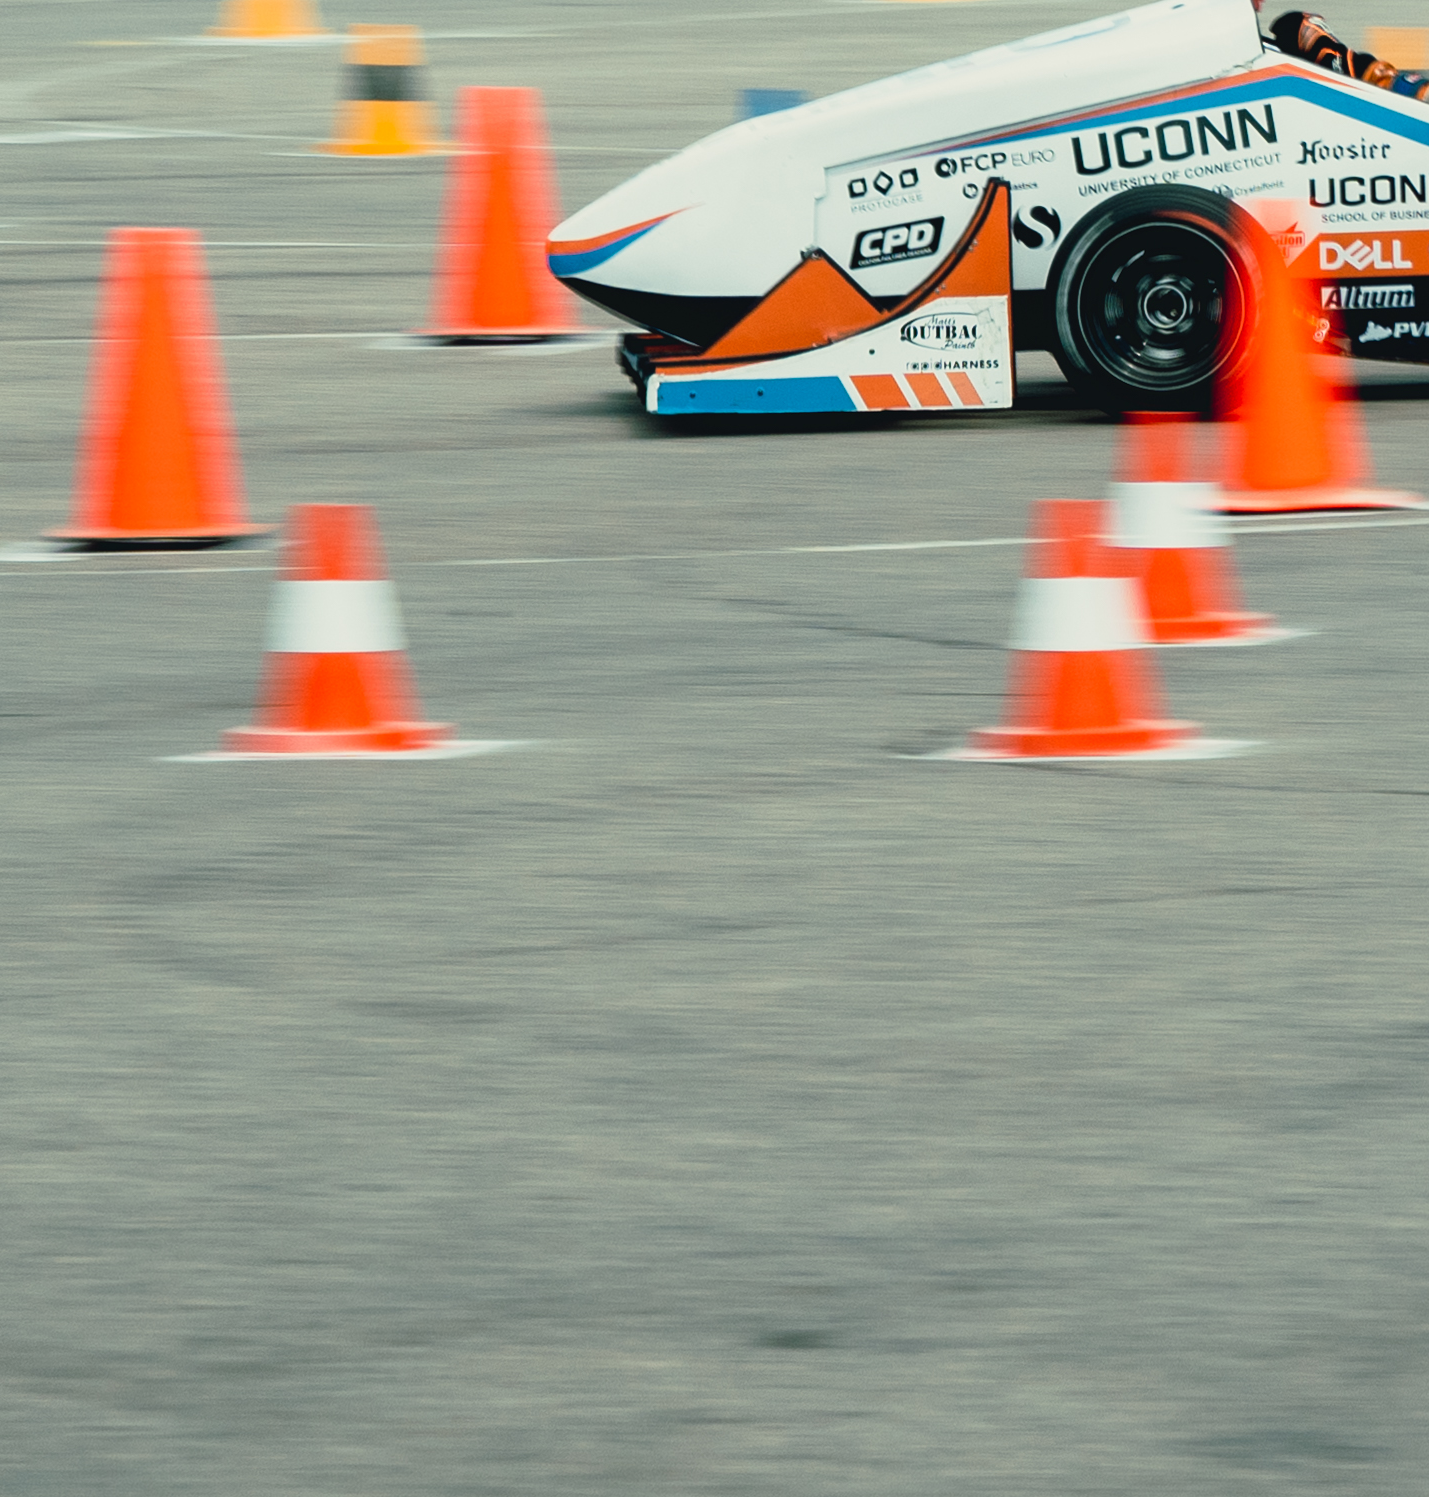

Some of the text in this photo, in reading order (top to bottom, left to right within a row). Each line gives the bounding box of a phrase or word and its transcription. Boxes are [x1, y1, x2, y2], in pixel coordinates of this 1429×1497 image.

[1071, 104, 1278, 176] UCONN
[1296, 138, 1391, 165] Hoosier
[960, 149, 1055, 174] FCP EURO
[1078, 152, 1281, 197] UNIVERSITY OF CONNECTICUT
[850, 194, 924, 213] PROTOCASE
[1321, 212, 1369, 223] SCHOOL
[1371, 211, 1387, 221] OF
[859, 221, 935, 258] CPD
[1319, 240, 1413, 271] DELL
[1324, 287, 1414, 310] Altium
[905, 324, 982, 340] OUTBAC
